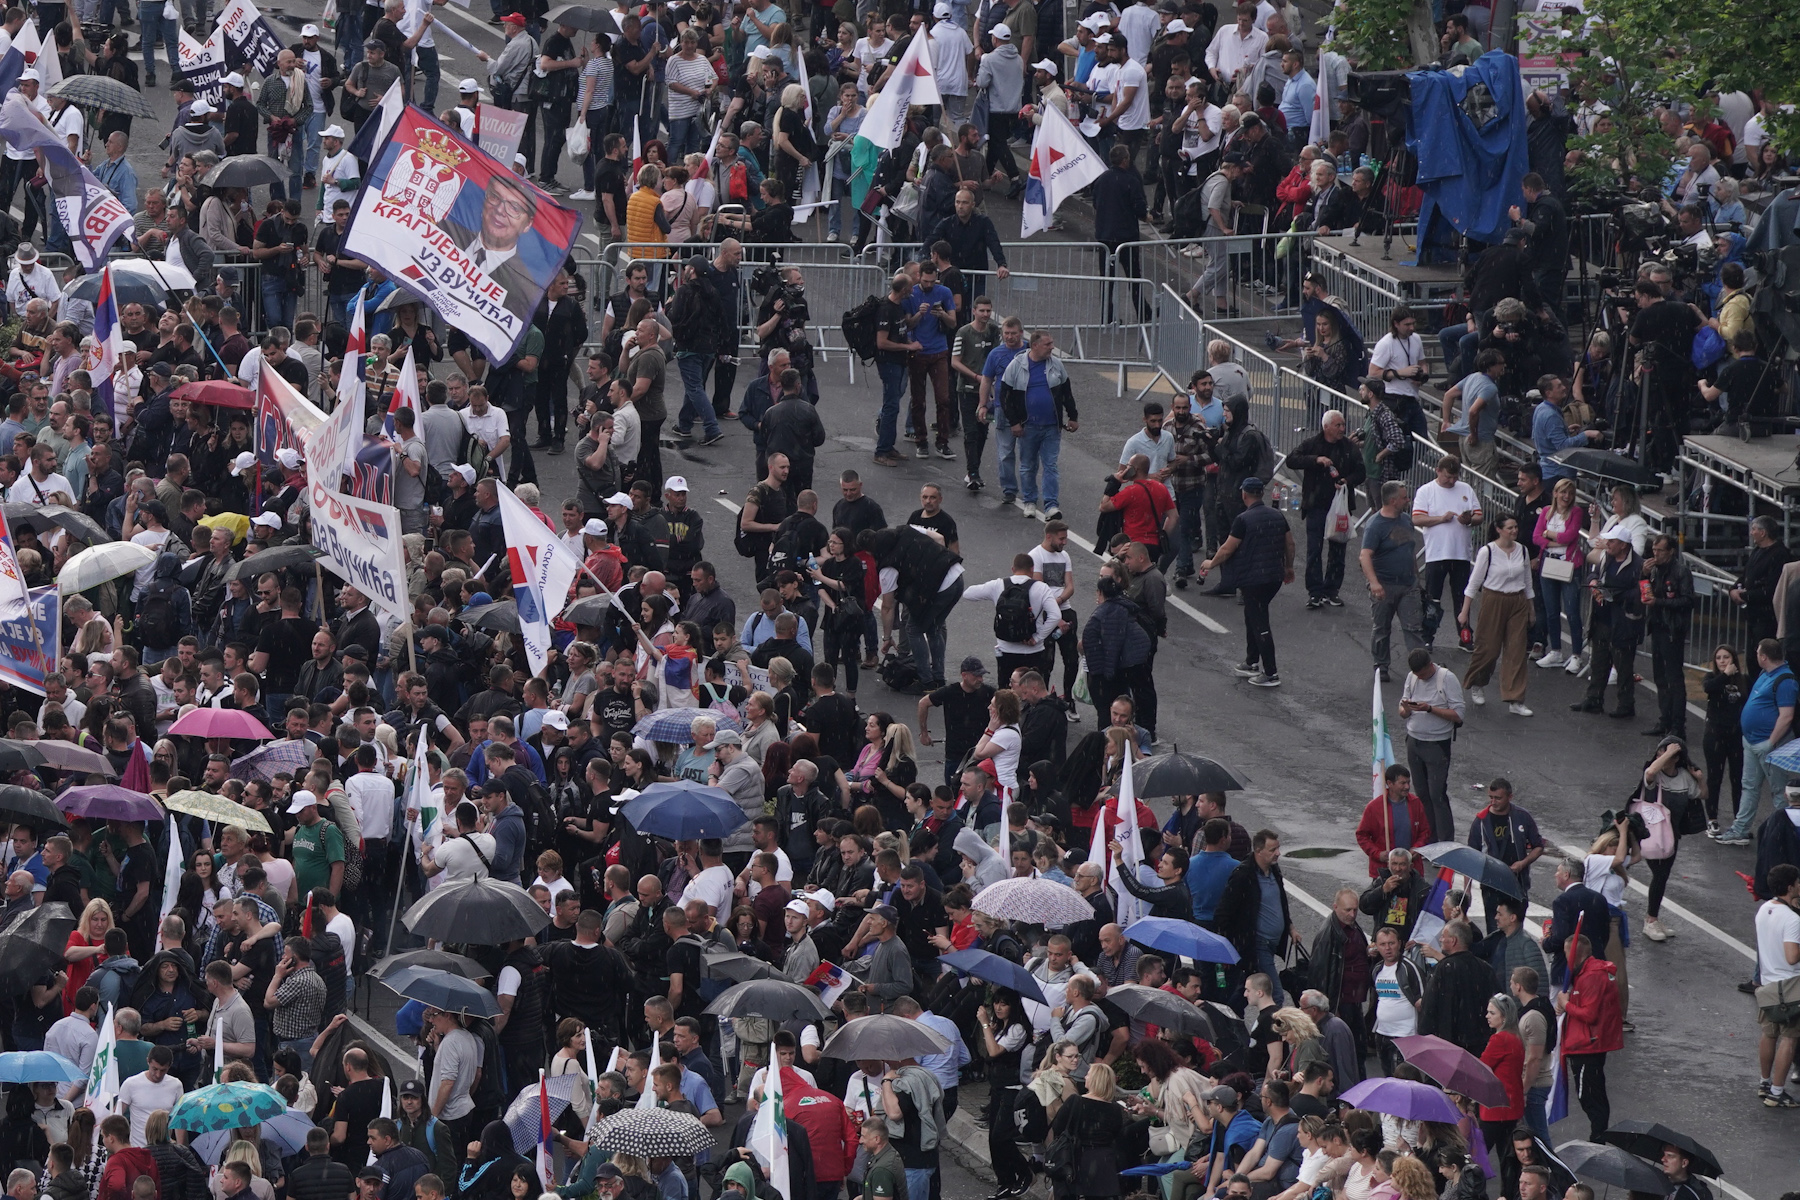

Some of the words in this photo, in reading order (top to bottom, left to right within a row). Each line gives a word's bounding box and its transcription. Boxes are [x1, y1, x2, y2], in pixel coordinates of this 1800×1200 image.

[372, 201, 483, 289] КРАГУЈЕВАЦ
[479, 278, 507, 302] ЈЕ
[419, 246, 440, 273] УЗ
[438, 266, 515, 330] ВУЧИЋА
[327, 524, 397, 604] Вучића
[603, 706, 633, 719] Original
[681, 767, 704, 780] JUST
